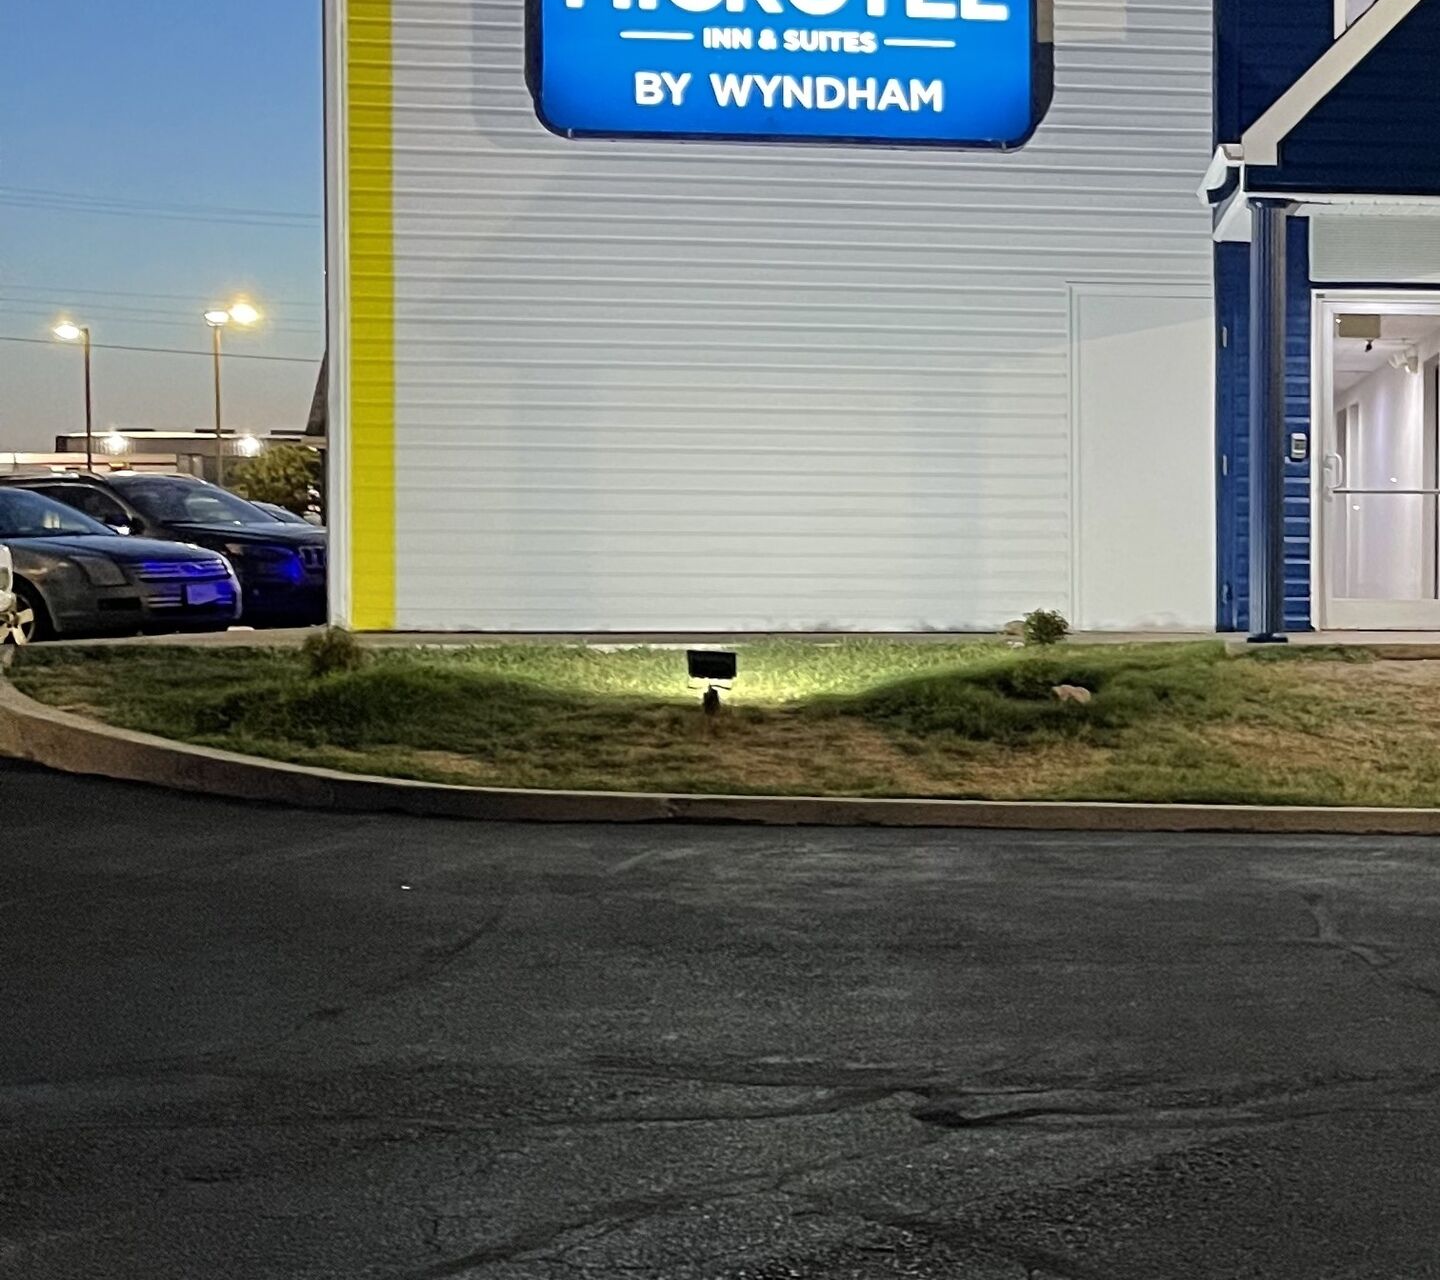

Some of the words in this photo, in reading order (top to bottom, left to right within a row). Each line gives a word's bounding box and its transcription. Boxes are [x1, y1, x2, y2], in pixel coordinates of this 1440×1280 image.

[703, 27, 752, 49] INN
[757, 28, 778, 50] &
[783, 29, 878, 54] SUITES
[634, 71, 691, 105] BY
[709, 73, 943, 112] WYNDHAM
